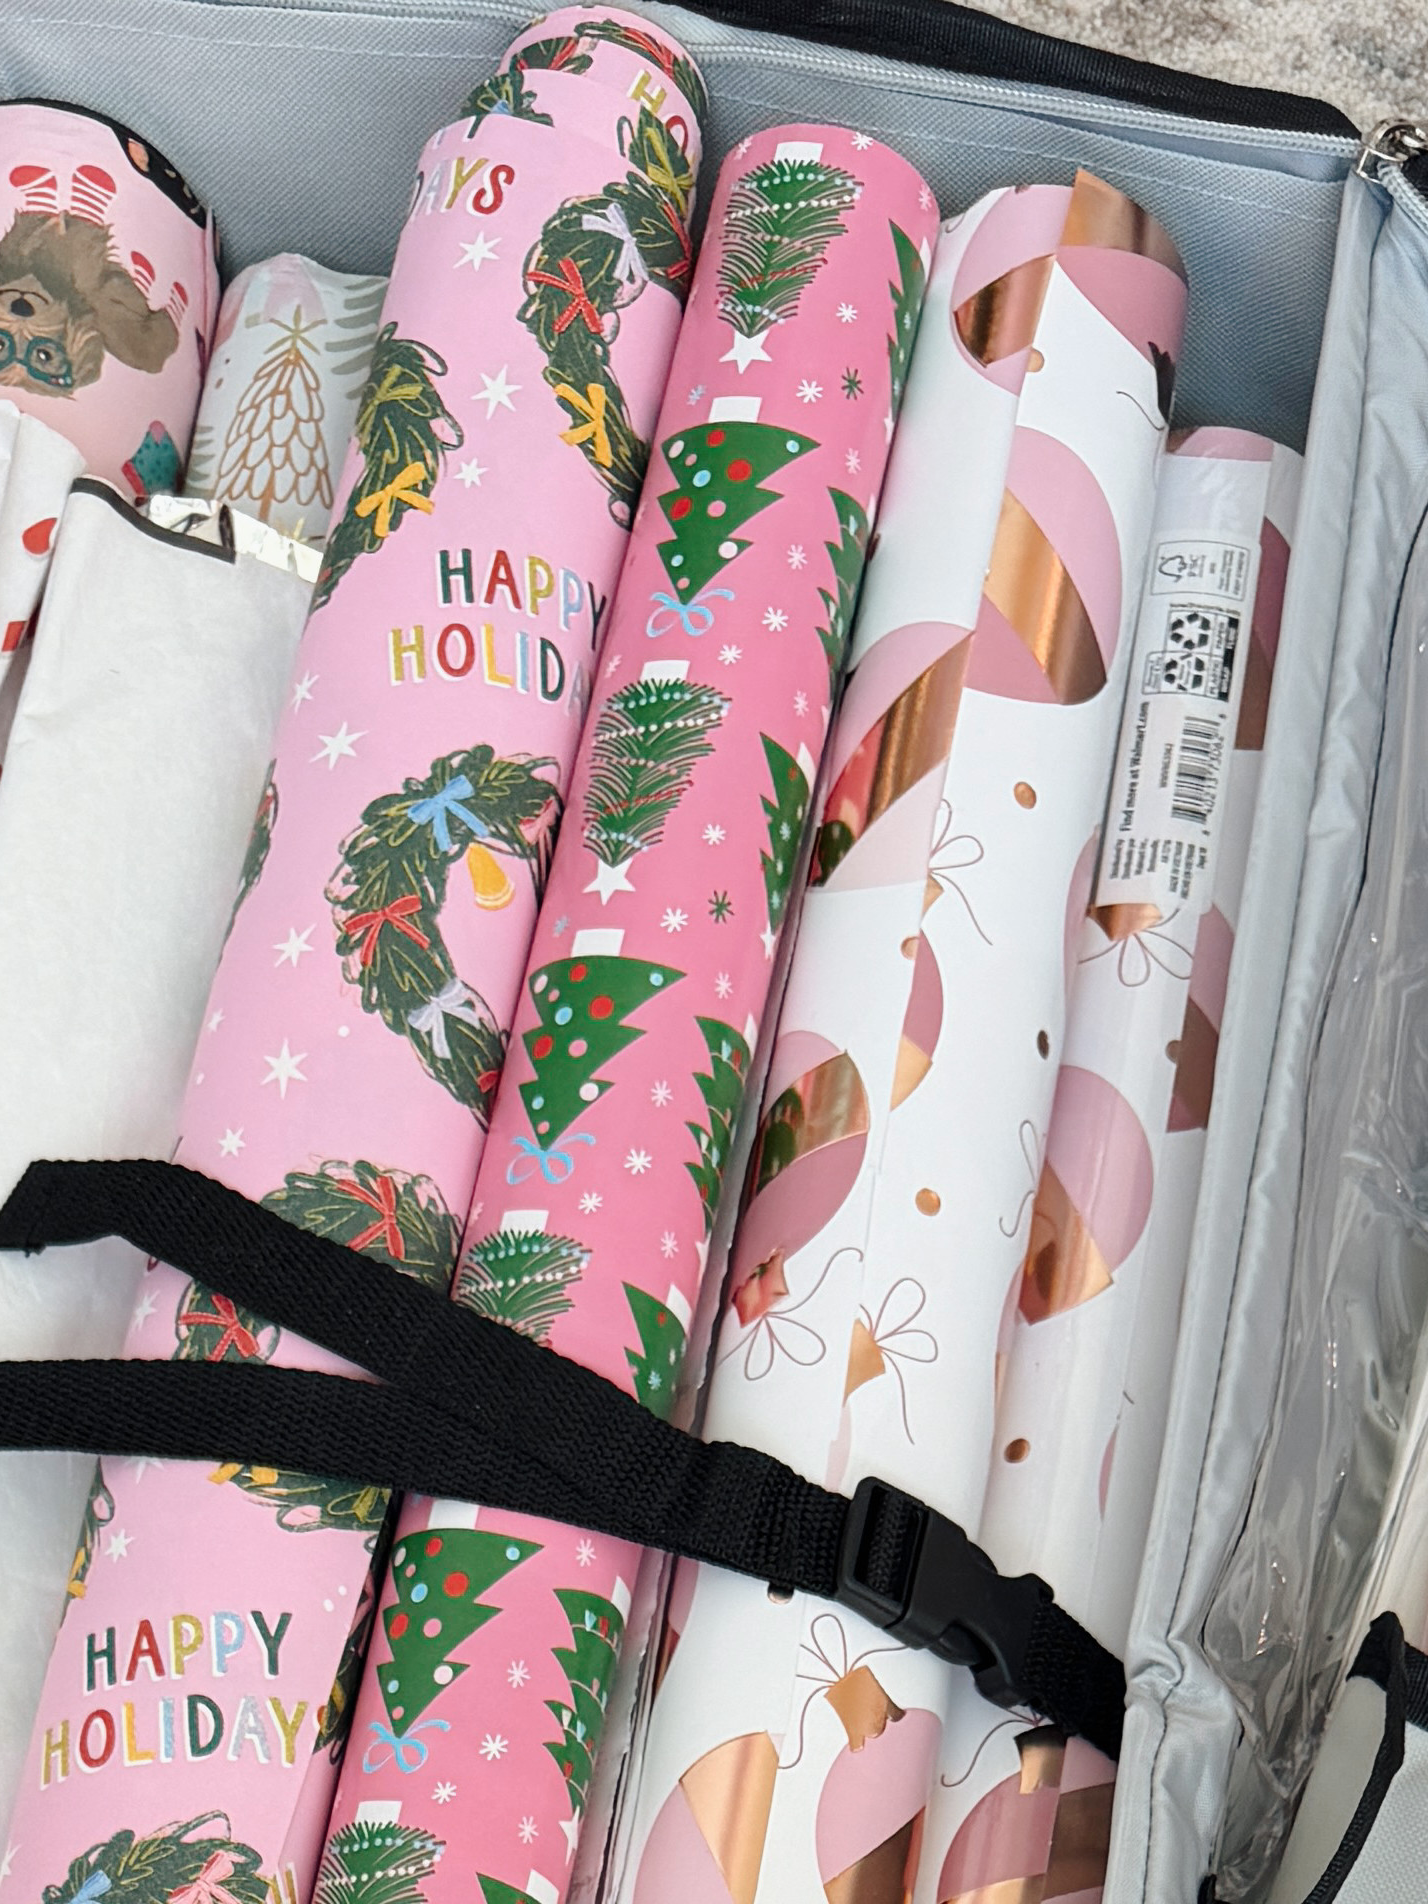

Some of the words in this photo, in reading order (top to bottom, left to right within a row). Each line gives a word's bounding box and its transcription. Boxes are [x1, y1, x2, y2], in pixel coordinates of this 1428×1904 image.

[436, 547, 607, 651] HAPPY
[83, 1610, 292, 1695] HAPPY
[40, 1694, 328, 1791] HOLIDAY
